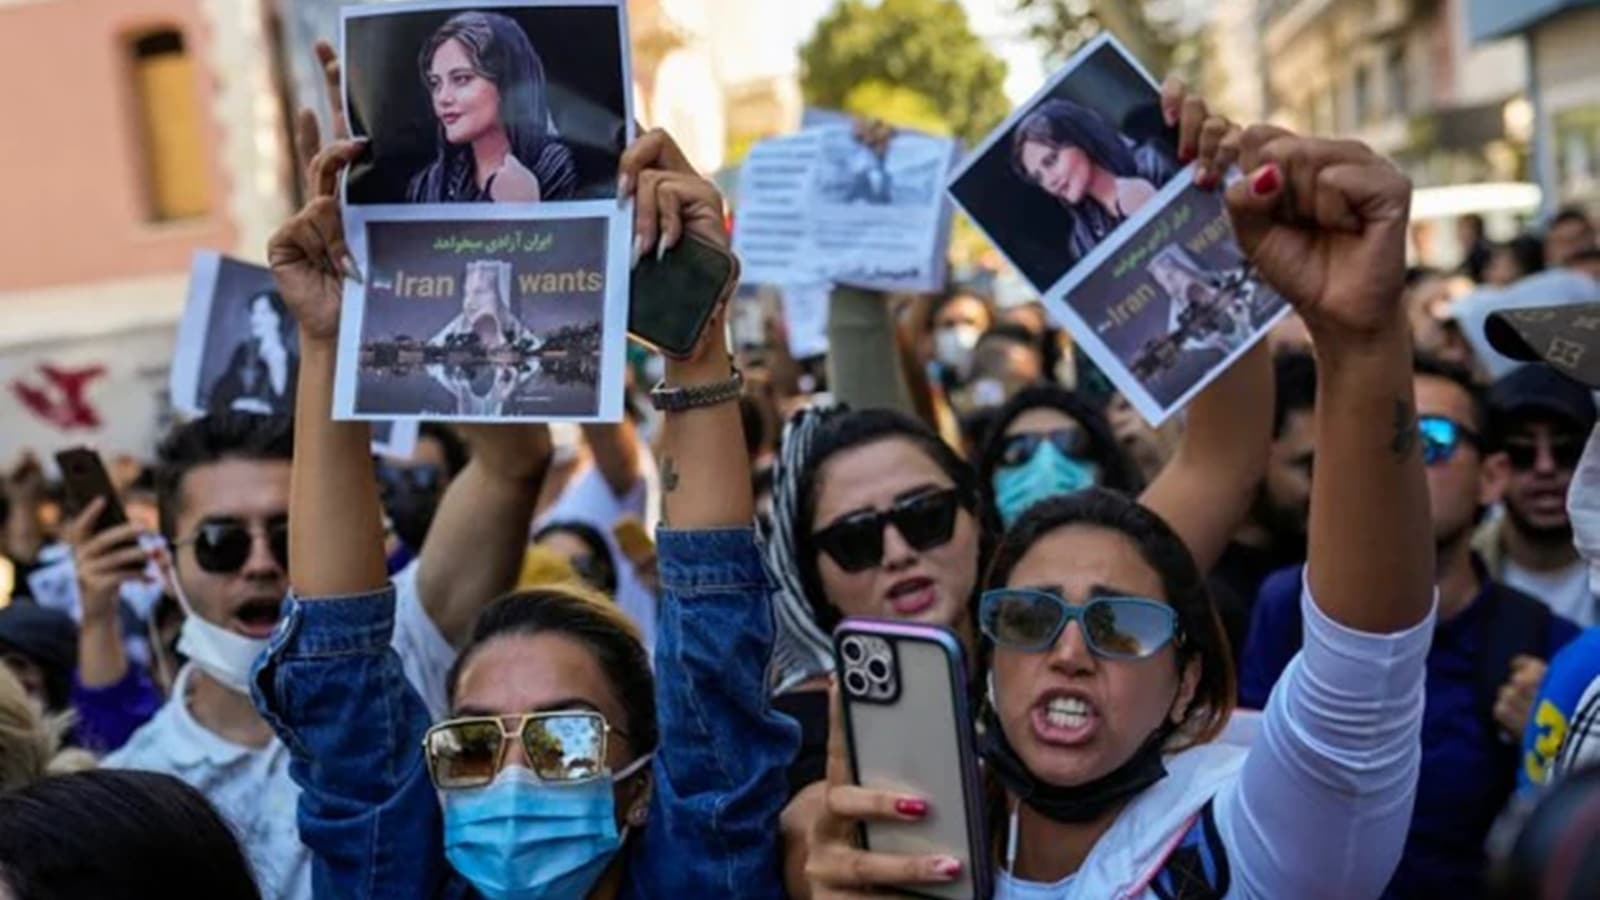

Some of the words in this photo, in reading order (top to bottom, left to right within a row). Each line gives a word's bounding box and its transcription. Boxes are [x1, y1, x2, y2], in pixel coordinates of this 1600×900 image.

[395, 270, 455, 297] Iran
[518, 268, 603, 294] wants
[1106, 282, 1156, 326] Iran
